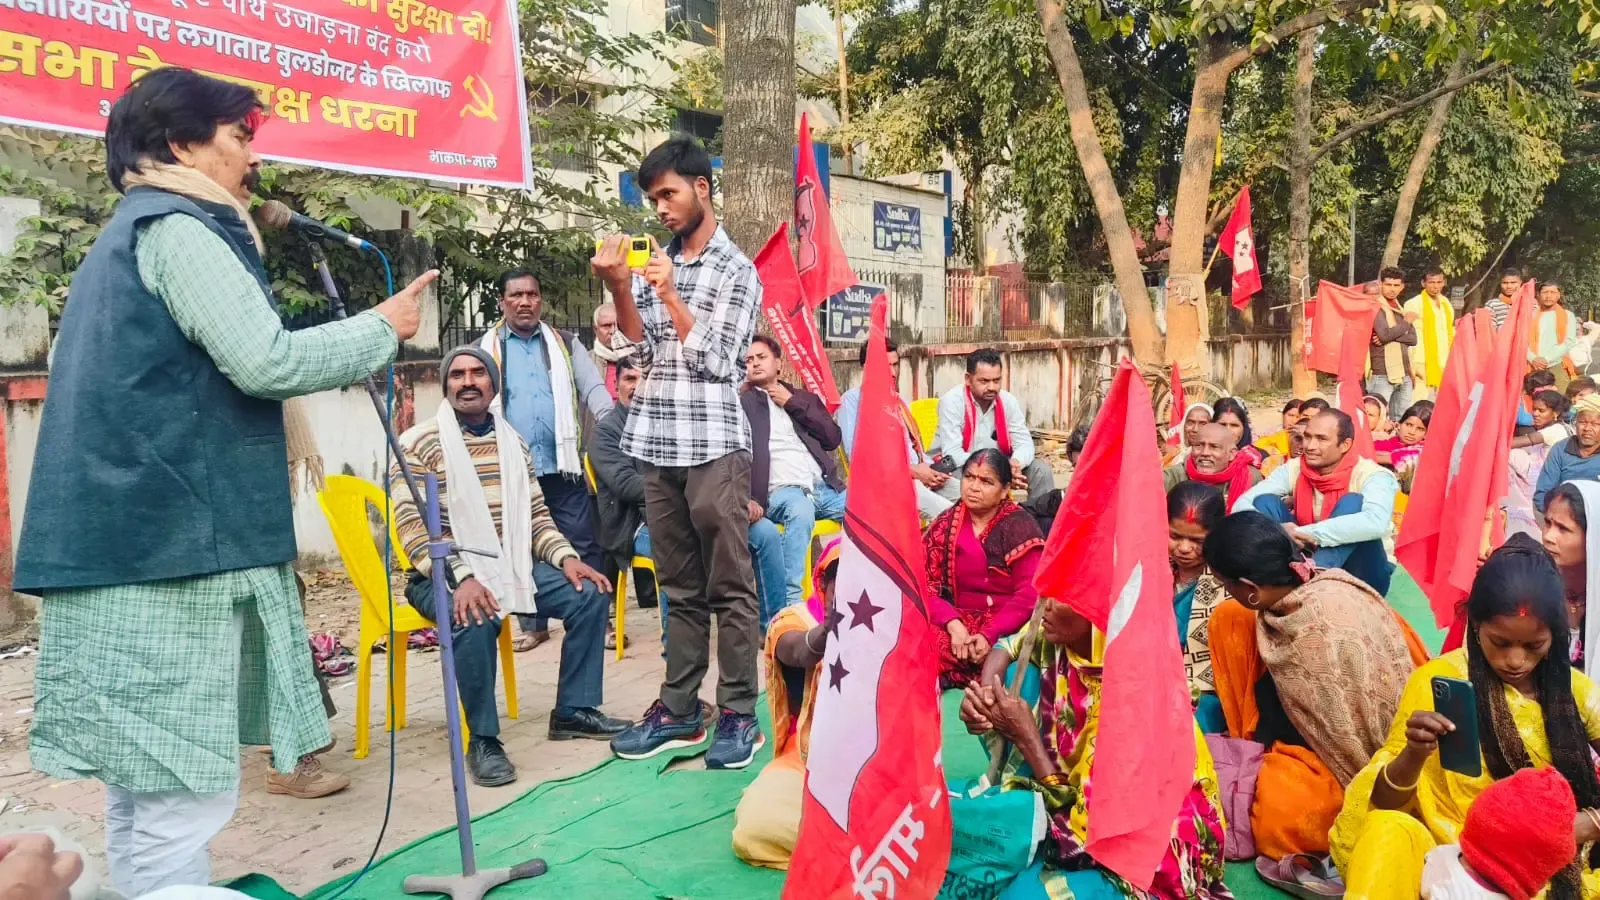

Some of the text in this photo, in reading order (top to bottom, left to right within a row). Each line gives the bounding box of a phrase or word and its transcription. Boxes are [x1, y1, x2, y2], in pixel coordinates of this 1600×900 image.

[273, 3, 361, 45] उजाड़ना
[366, 26, 392, 56] बंद
[396, 36, 433, 63] करो
[386, 0, 493, 44] सुरक्षा दो!
[134, 11, 171, 42] पर
[175, 20, 271, 64] लगातार
[275, 44, 358, 84] बुलडोजर
[360, 60, 378, 88] के
[382, 65, 452, 99] खिलाफ
[320, 95, 418, 138] धरना
[429, 149, 497, 169] भाकपा-माले
[886, 205, 910, 222] Sudha
[844, 287, 873, 304] Sudha
